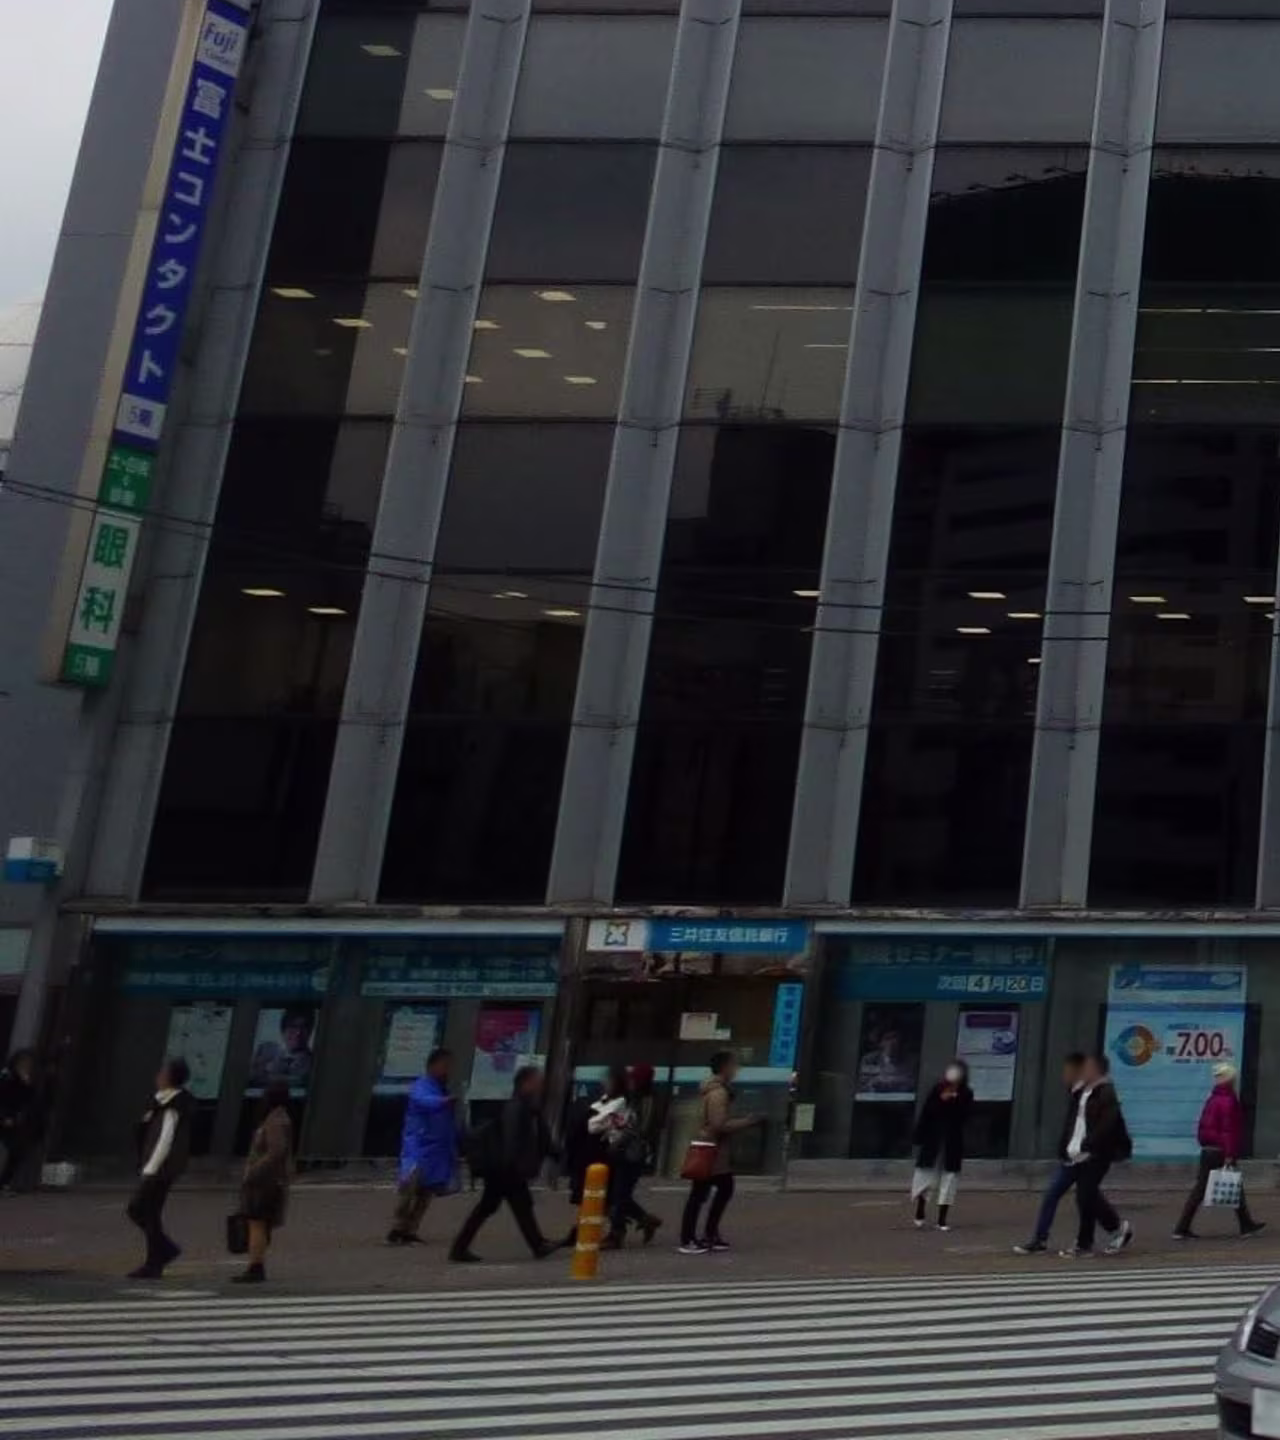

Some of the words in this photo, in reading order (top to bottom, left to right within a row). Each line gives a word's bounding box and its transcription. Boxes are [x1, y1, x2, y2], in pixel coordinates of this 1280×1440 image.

[137, 78, 226, 385] 富士コンタクト
[79, 523, 129, 634] 眼科
